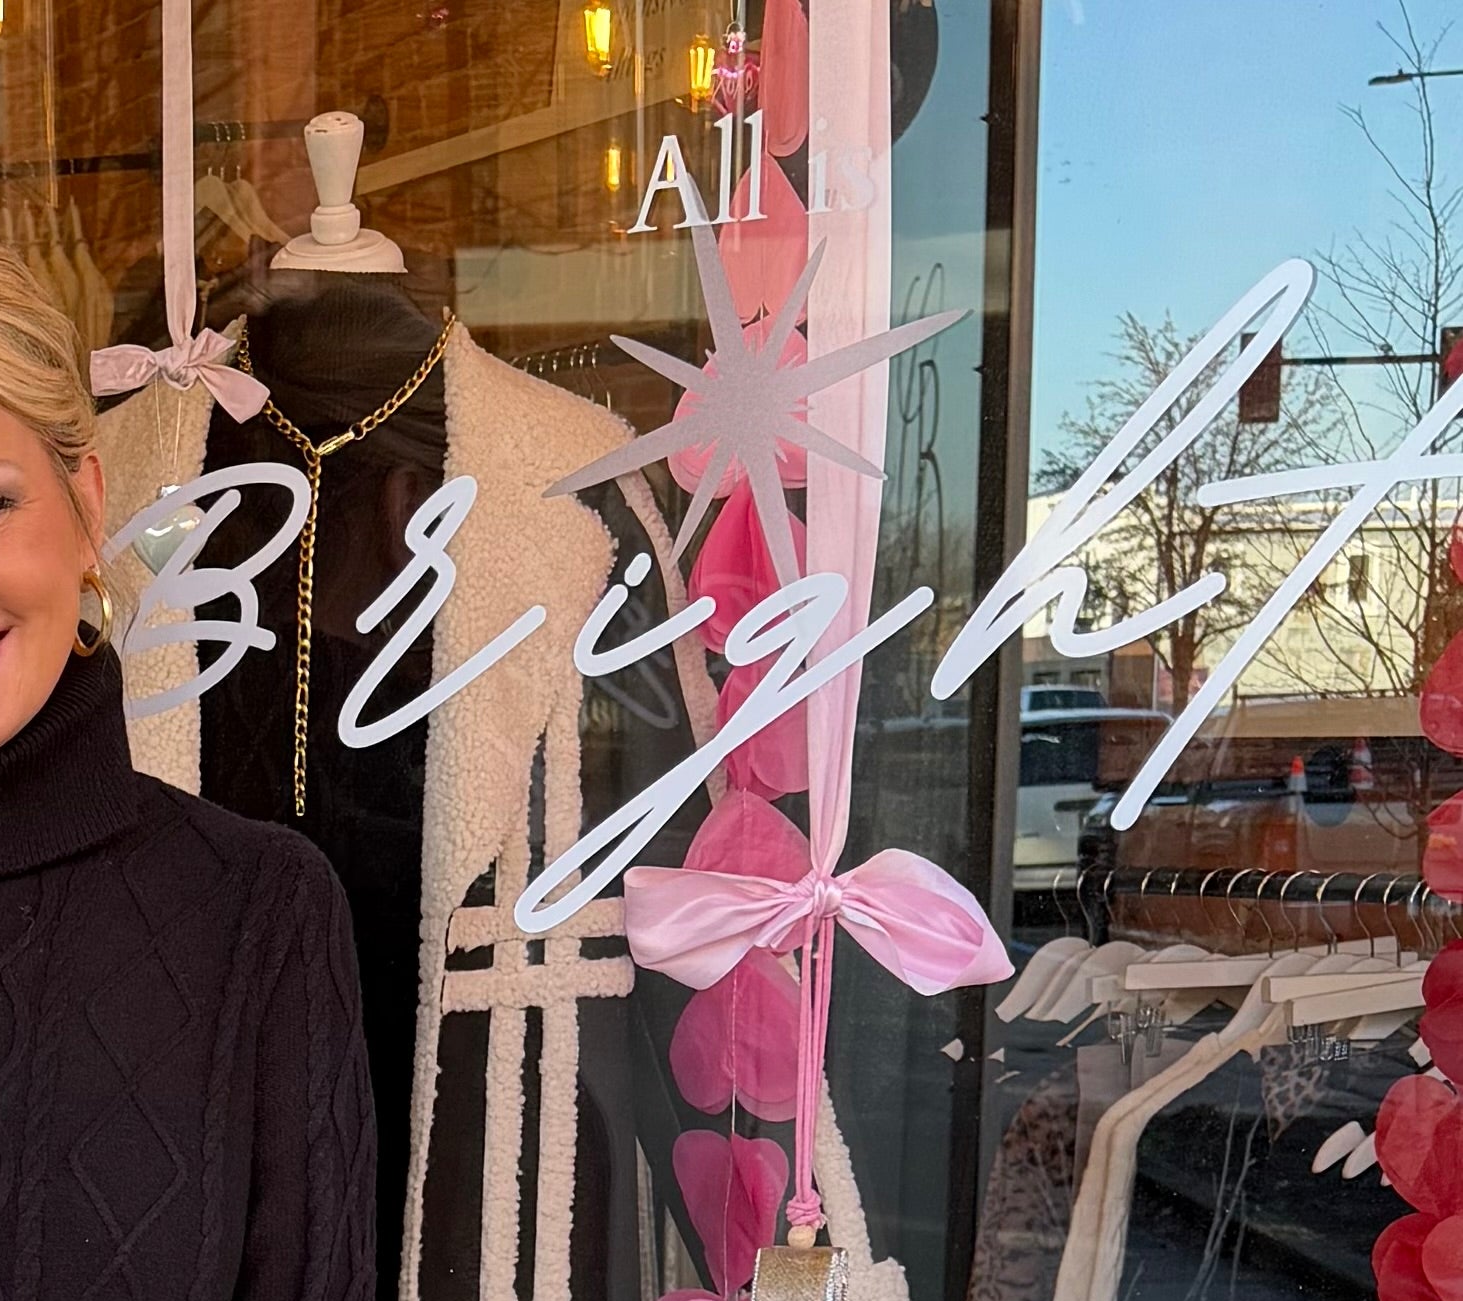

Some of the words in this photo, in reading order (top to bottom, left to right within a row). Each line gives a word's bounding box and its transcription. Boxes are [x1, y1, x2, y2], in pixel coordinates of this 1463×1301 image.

[626, 109, 768, 234] All
[805, 116, 875, 215] is
[99, 257, 1463, 936] Bright
